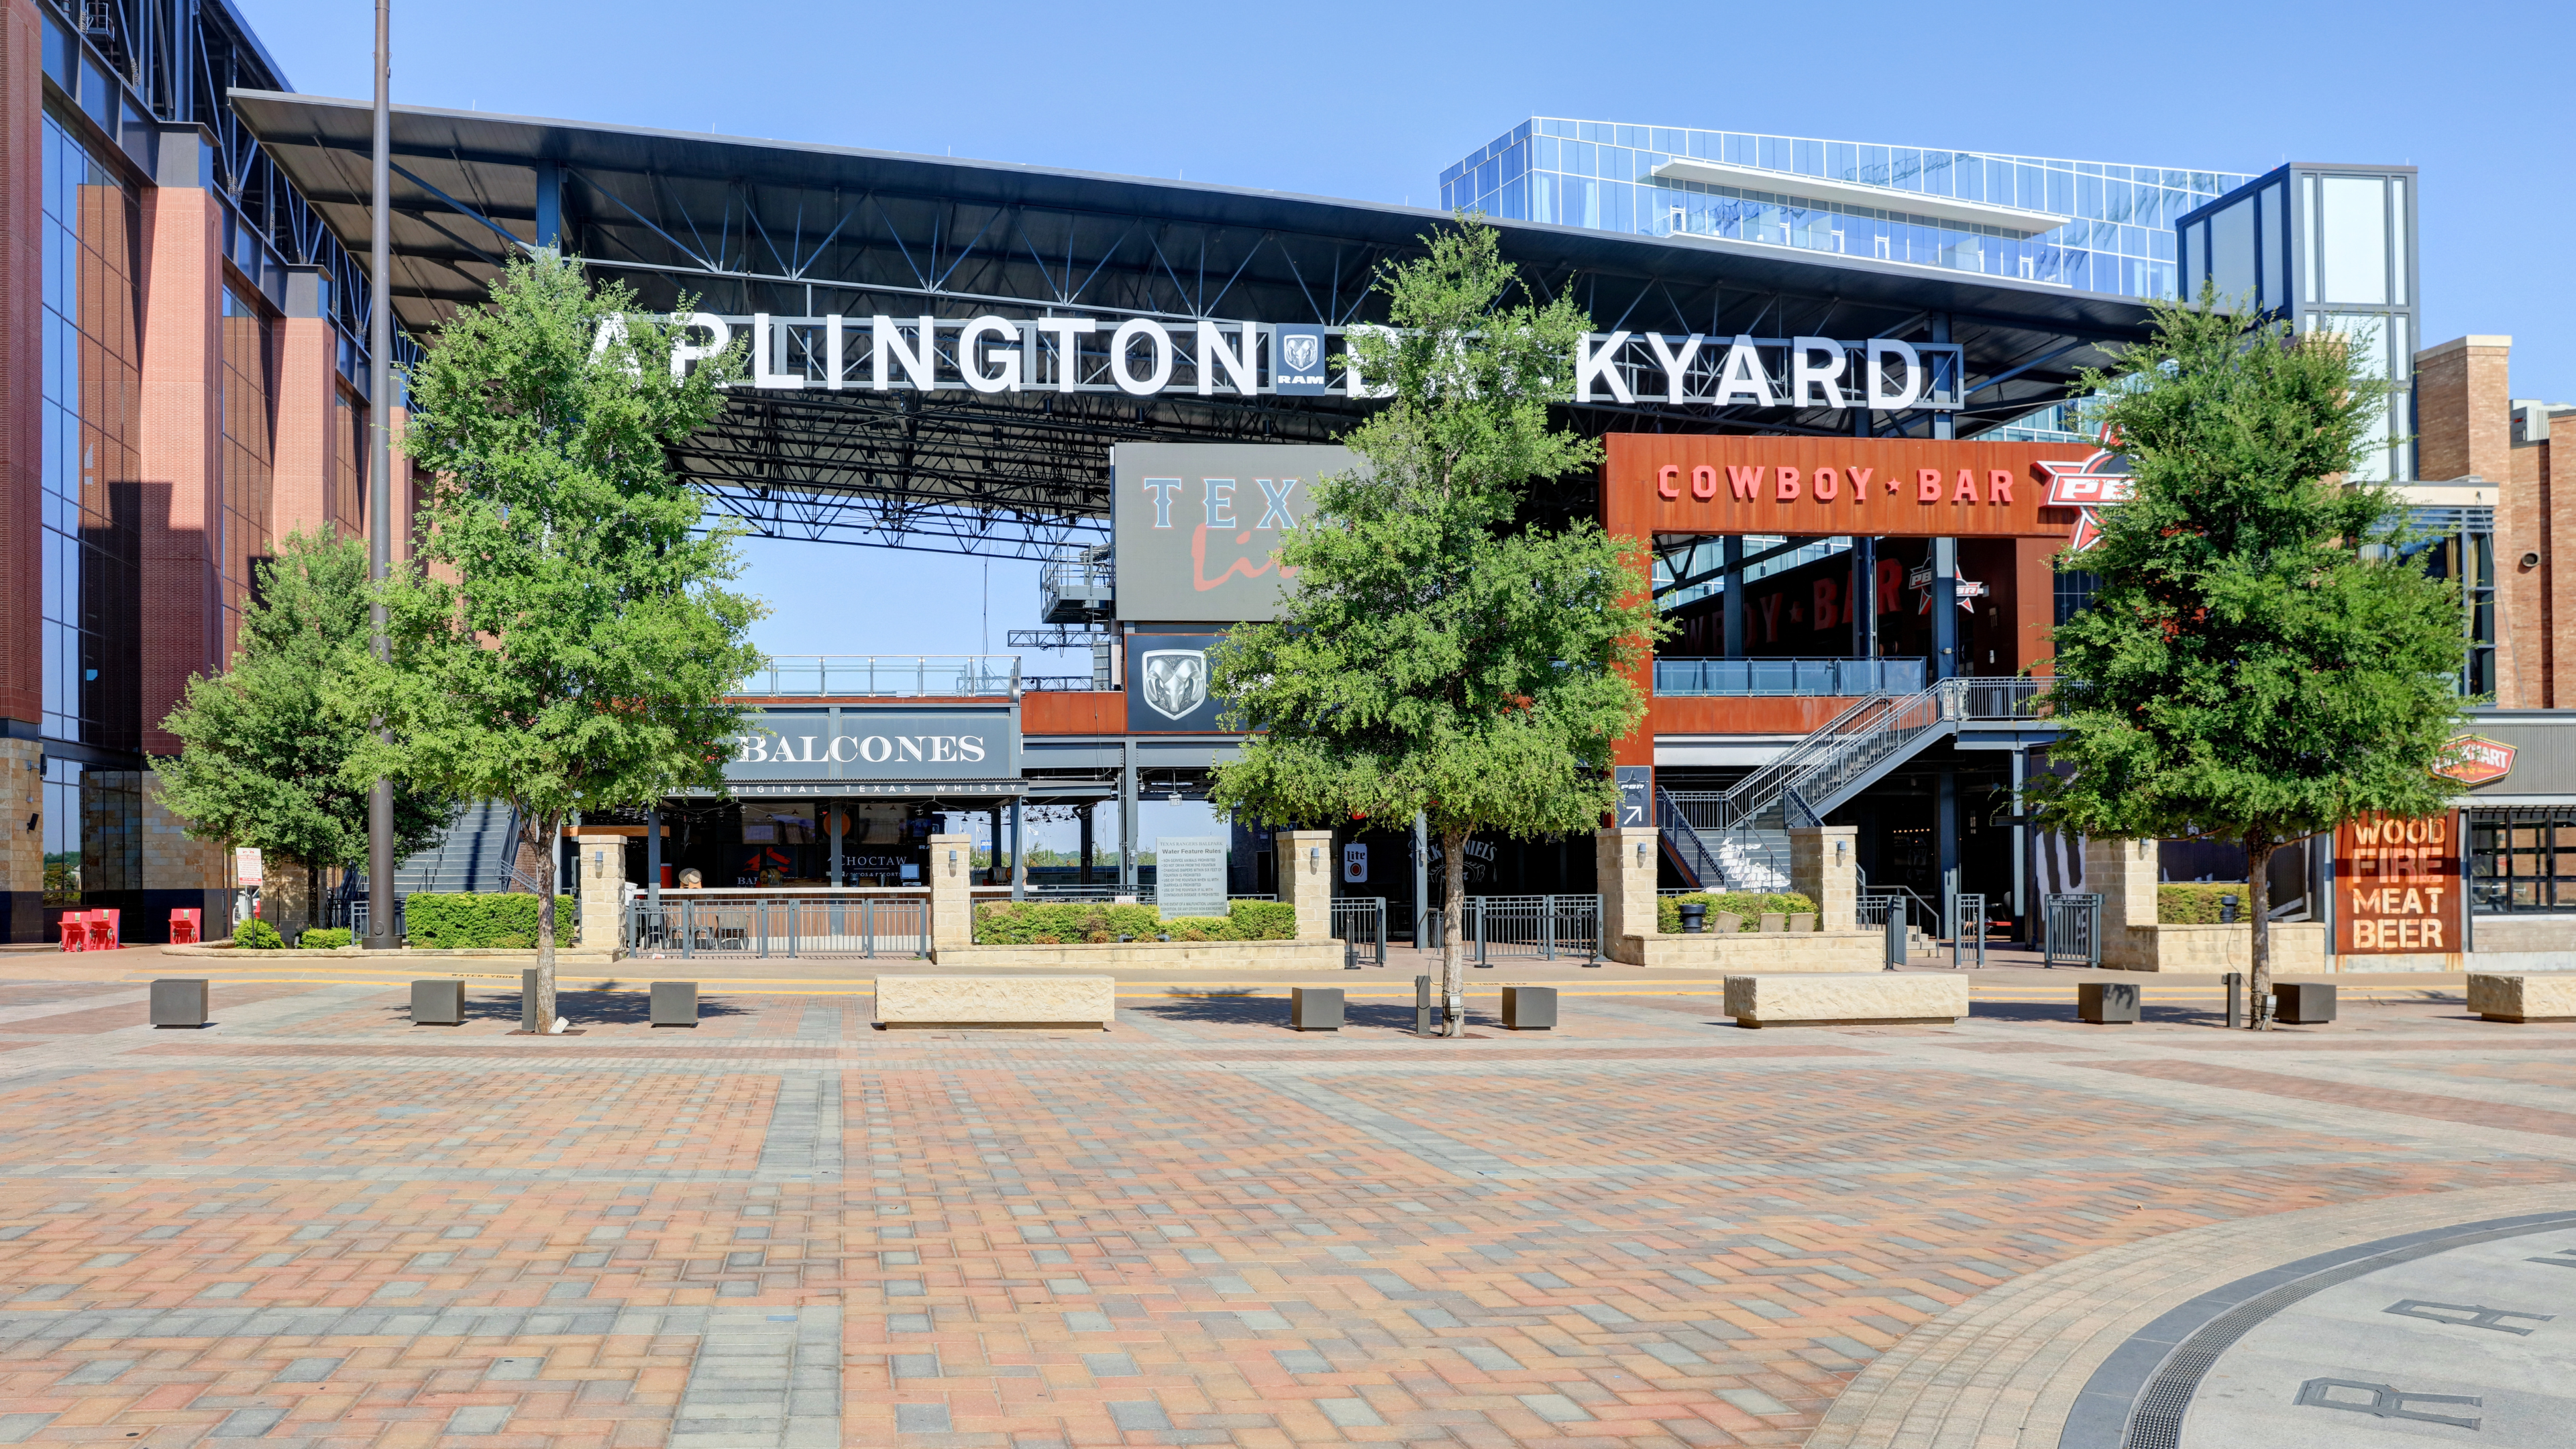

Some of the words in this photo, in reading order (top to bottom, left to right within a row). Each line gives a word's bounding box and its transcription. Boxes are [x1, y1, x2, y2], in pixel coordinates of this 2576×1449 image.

[582, 311, 1257, 396] ARLINGTON
[1346, 323, 1921, 411] BKYARD
[1278, 375, 1324, 384] RAM
[1658, 464, 1874, 500] COWBOY
[1917, 468, 2013, 503] BAR
[2061, 478, 2139, 500] PB
[1142, 476, 1352, 530] TEX
[1912, 571, 1932, 586] PB
[735, 735, 985, 763] BALCONES
[718, 785, 820, 793] RIGINAL
[845, 785, 911, 793] TEXAS
[936, 784, 1016, 792] WHISKY
[2351, 818, 2446, 845] WOOD
[1346, 851, 1366, 863] Lite
[1463, 840, 1497, 861] NIEL'S
[2353, 847, 2444, 883] FIRE
[2353, 887, 2444, 914] MEAT
[2353, 918, 2444, 949] BEER
